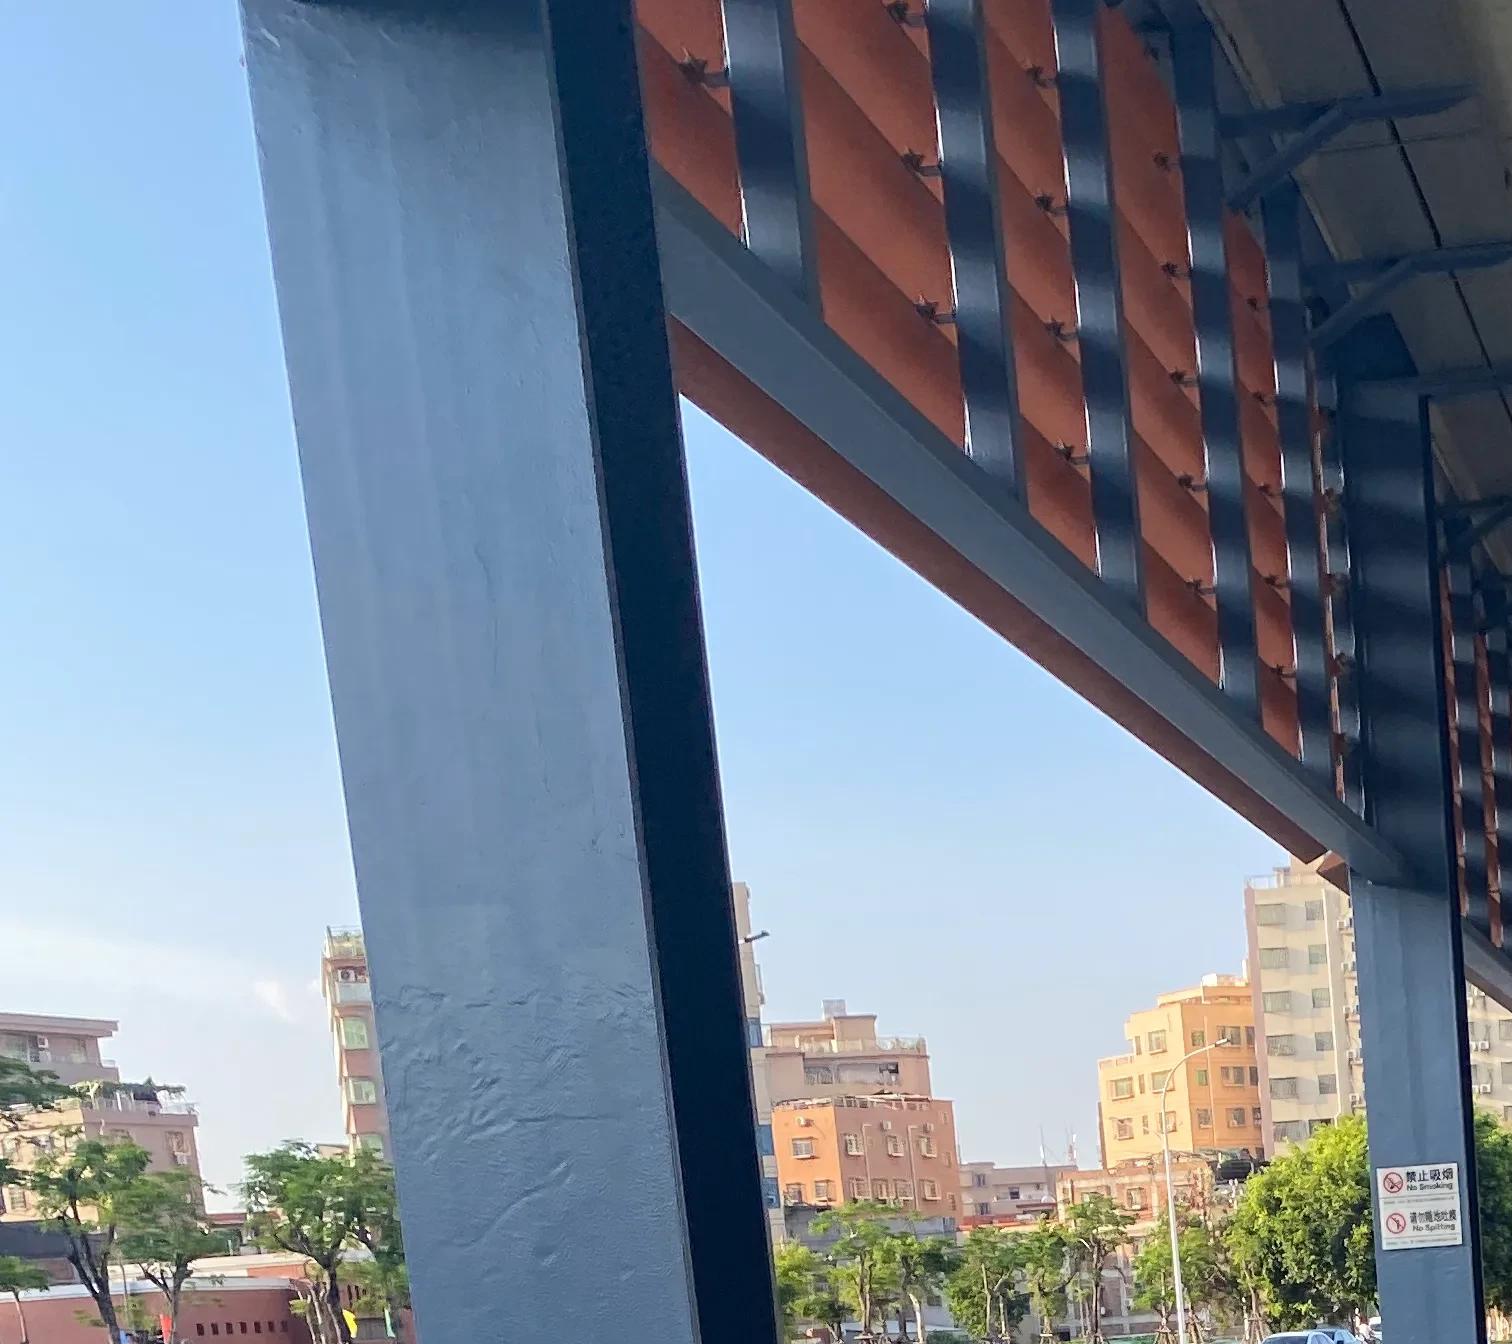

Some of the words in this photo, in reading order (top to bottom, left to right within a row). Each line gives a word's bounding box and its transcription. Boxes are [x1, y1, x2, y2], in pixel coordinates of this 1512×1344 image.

[1406, 1167, 1454, 1183] 禁止吸烟
[1406, 1184, 1418, 1192] No
[1420, 1181, 1453, 1192] Smoking
[1412, 1225, 1423, 1233] No
[1425, 1223, 1456, 1234] Spitting
